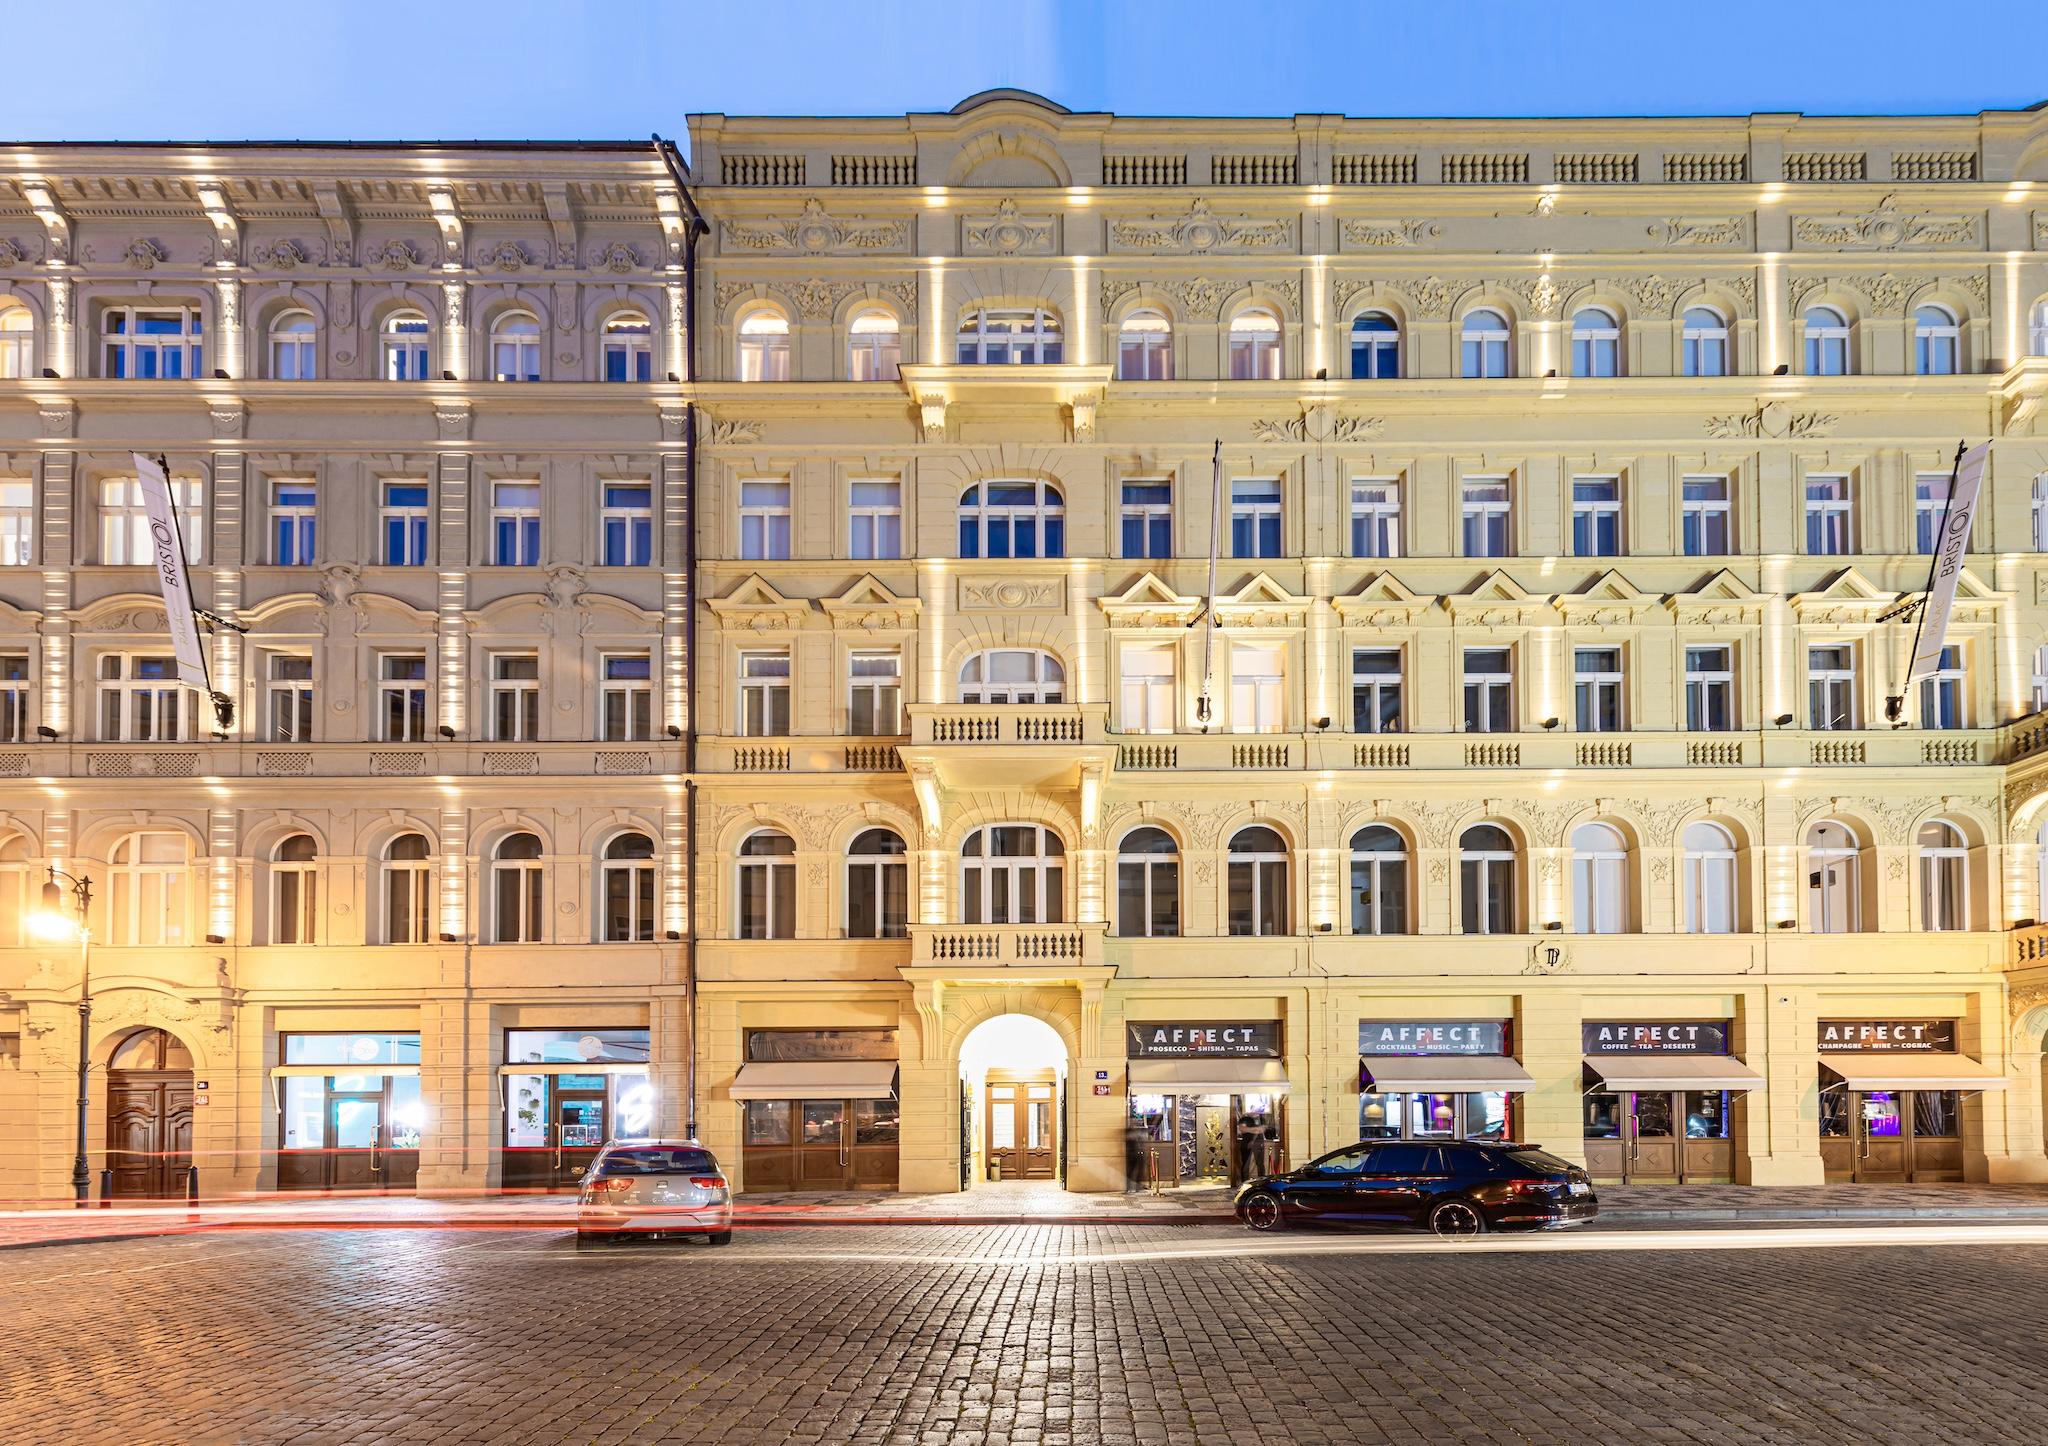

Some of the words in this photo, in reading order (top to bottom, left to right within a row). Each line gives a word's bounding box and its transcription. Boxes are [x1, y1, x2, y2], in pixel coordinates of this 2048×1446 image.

[1940, 500, 1971, 578] BRISTOL
[152, 517, 179, 587] BRISTOL
[1153, 1028, 1253, 1042] AFFECT
[1380, 1027, 1480, 1041] AFFECT
[1599, 1026, 1699, 1041] AFFECT
[1824, 1026, 1924, 1040] AFFECT
